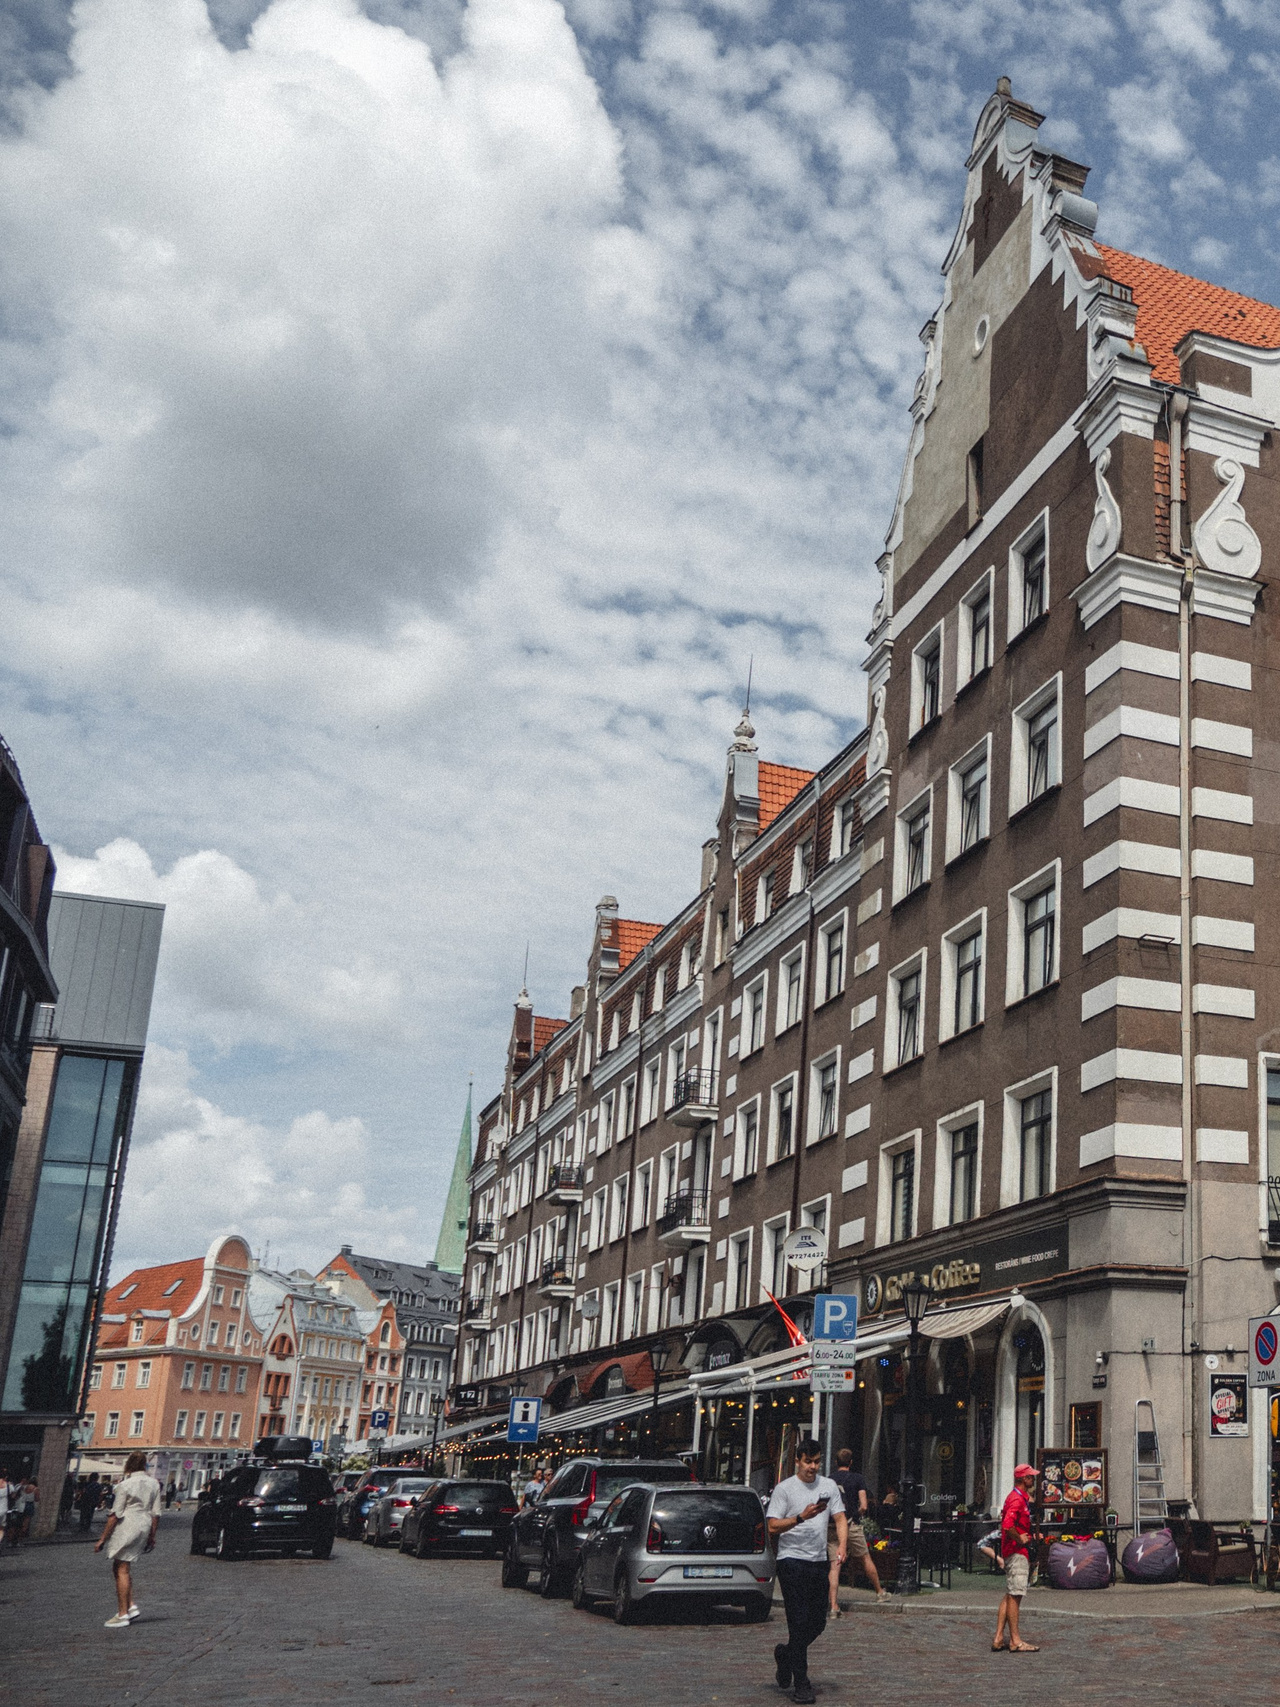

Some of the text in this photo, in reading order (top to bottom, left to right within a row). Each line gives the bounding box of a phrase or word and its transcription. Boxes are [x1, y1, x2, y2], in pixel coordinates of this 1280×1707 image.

[932, 1259, 981, 1291] Coffee
[823, 1300, 848, 1334] P
[1257, 1370, 1276, 1382] ZONA
[374, 1412, 386, 1426] P
[930, 1493, 957, 1501] Golden
